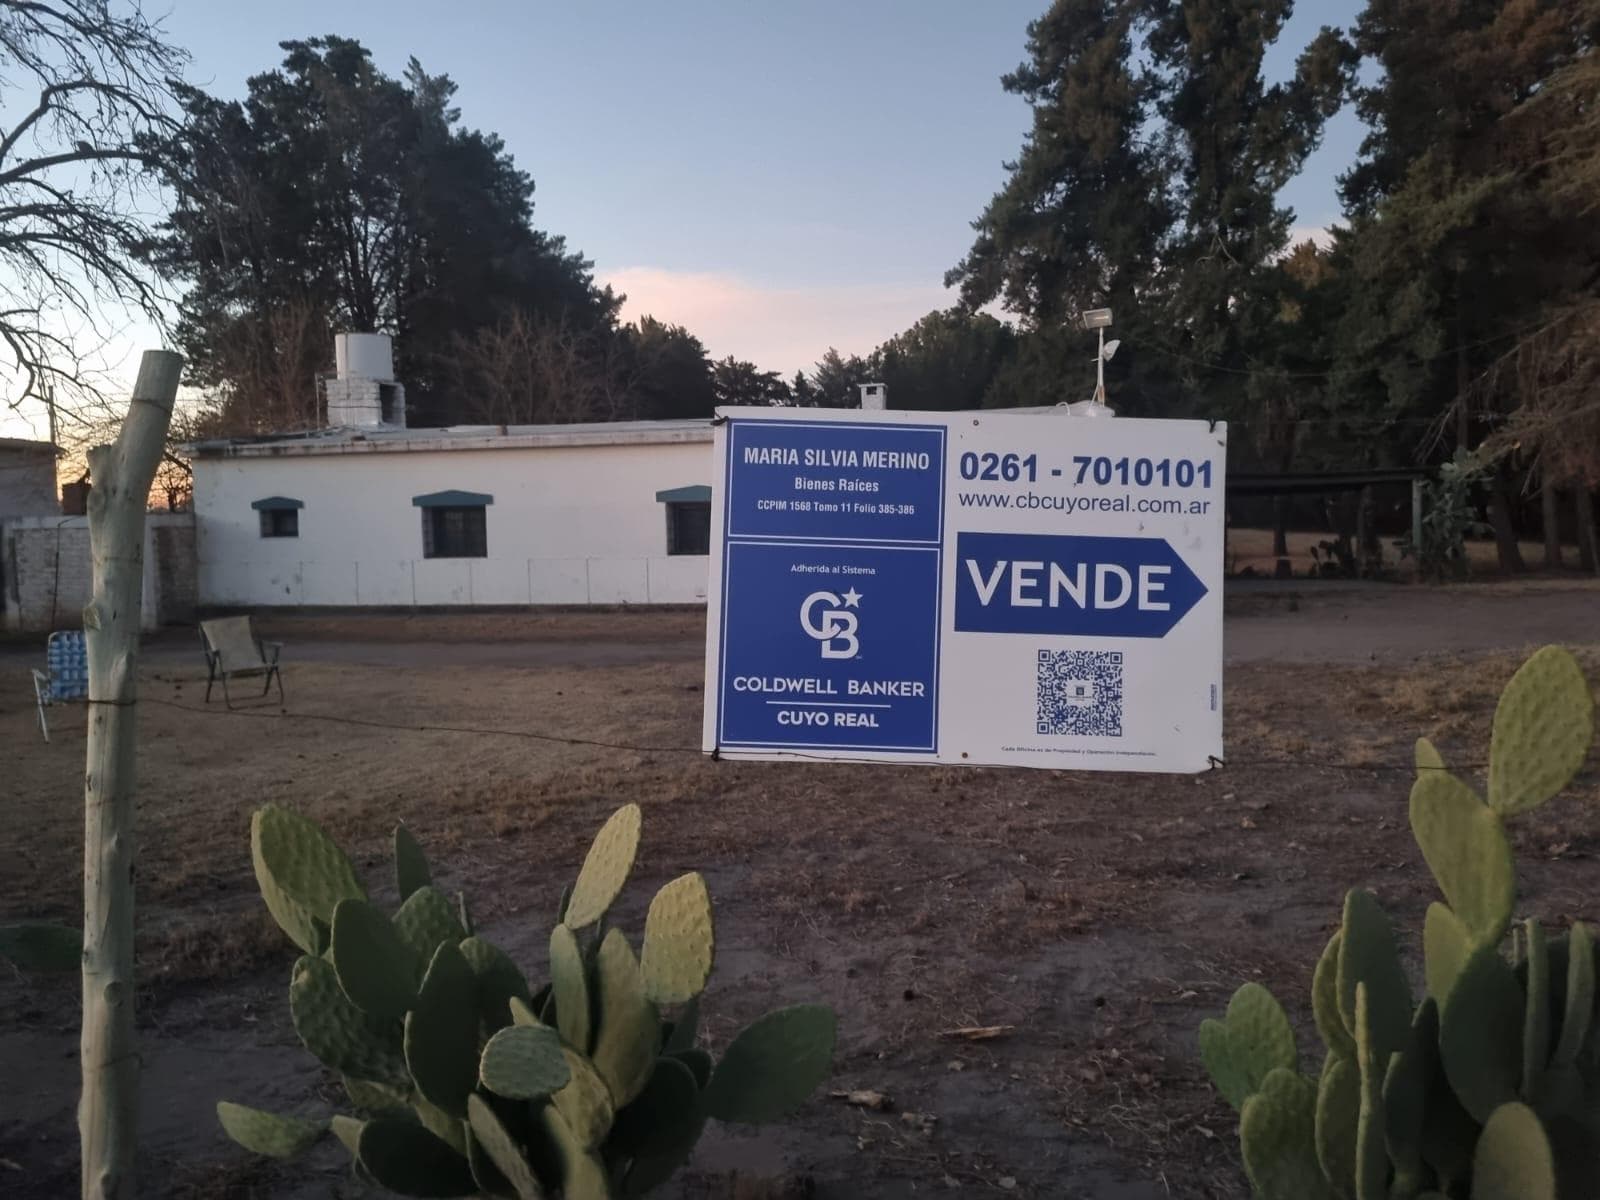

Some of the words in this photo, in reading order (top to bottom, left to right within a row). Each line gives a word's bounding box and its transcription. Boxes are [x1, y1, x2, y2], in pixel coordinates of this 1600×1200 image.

[744, 447, 799, 465] MARIA
[804, 449, 858, 468] SILVIA
[862, 450, 930, 470] MERINO
[960, 451, 1037, 482] 0261
[1073, 456, 1212, 488] 7010101
[794, 477, 835, 491] Bienes
[838, 478, 880, 492] Raíces
[757, 500, 787, 511] CCPIM
[814, 502, 838, 512] Tomo
[840, 503, 851, 513] 11
[854, 503, 876, 514] Folio
[878, 504, 915, 515] 385-386
[958, 491, 1210, 514] www.cbcuyoreal.com.ar
[790, 564, 830, 574] Adherida
[832, 566, 840, 574] al
[842, 566, 876, 575] Sistema
[965, 559, 1172, 611] VENDE
[733, 676, 838, 694] COLDWELL
[847, 680, 925, 698] BANKER
[777, 711, 830, 726] CUYO
[834, 712, 880, 728] REAL
